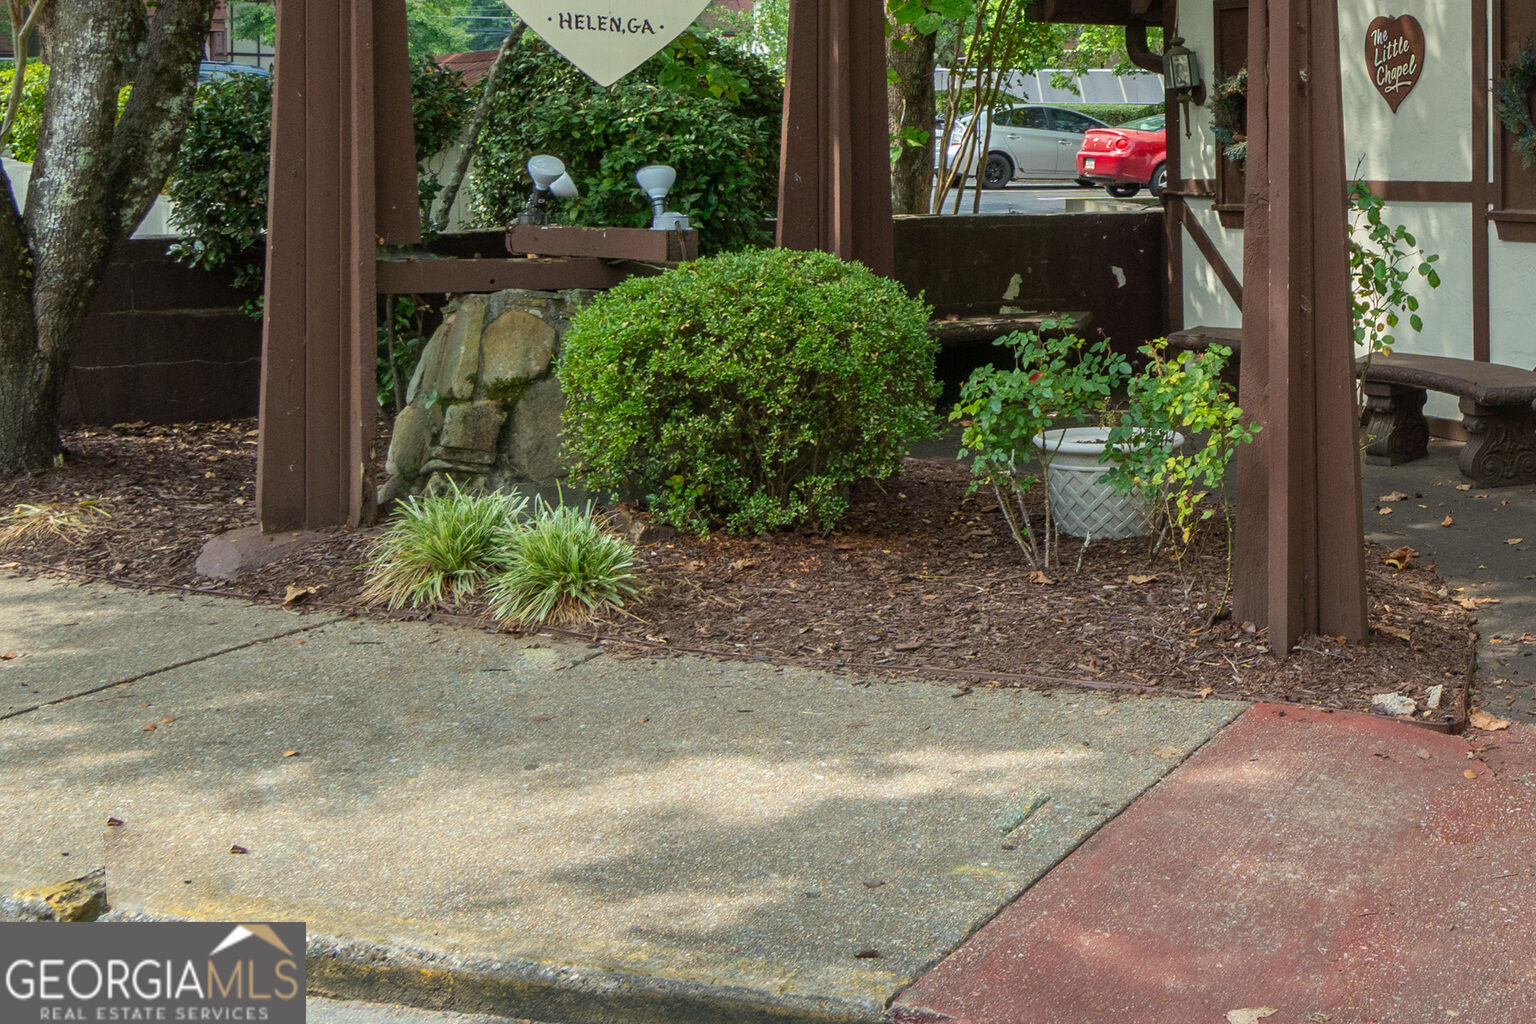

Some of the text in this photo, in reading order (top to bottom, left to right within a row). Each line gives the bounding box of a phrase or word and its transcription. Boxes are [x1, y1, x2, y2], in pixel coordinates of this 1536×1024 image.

[1371, 28, 1388, 46] The
[1374, 36, 1410, 67] Little
[1376, 54, 1417, 93] Chapel
